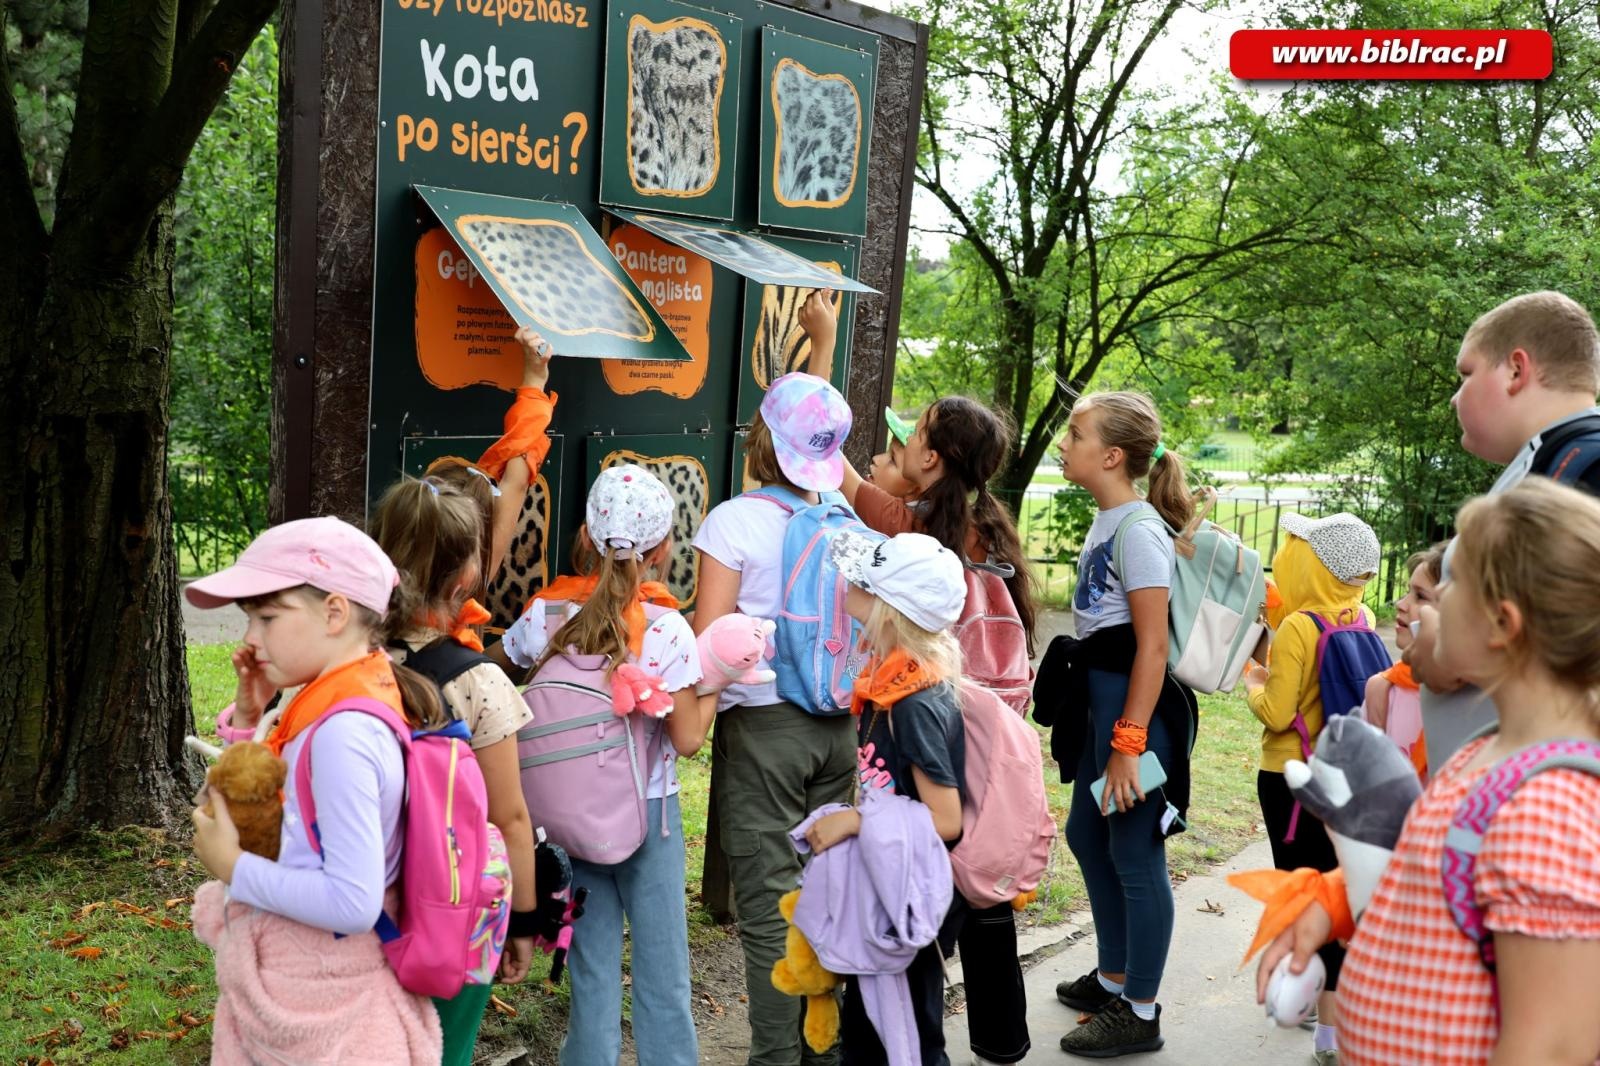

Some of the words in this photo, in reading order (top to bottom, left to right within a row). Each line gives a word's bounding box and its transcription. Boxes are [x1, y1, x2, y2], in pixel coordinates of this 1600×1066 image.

[420, 38, 539, 103] Kota
[396, 114, 439, 162] po
[451, 111, 588, 175] sierści?
[438, 250, 479, 289] Gep
[614, 242, 687, 275] Pantera
[641, 278, 703, 307] mglista
